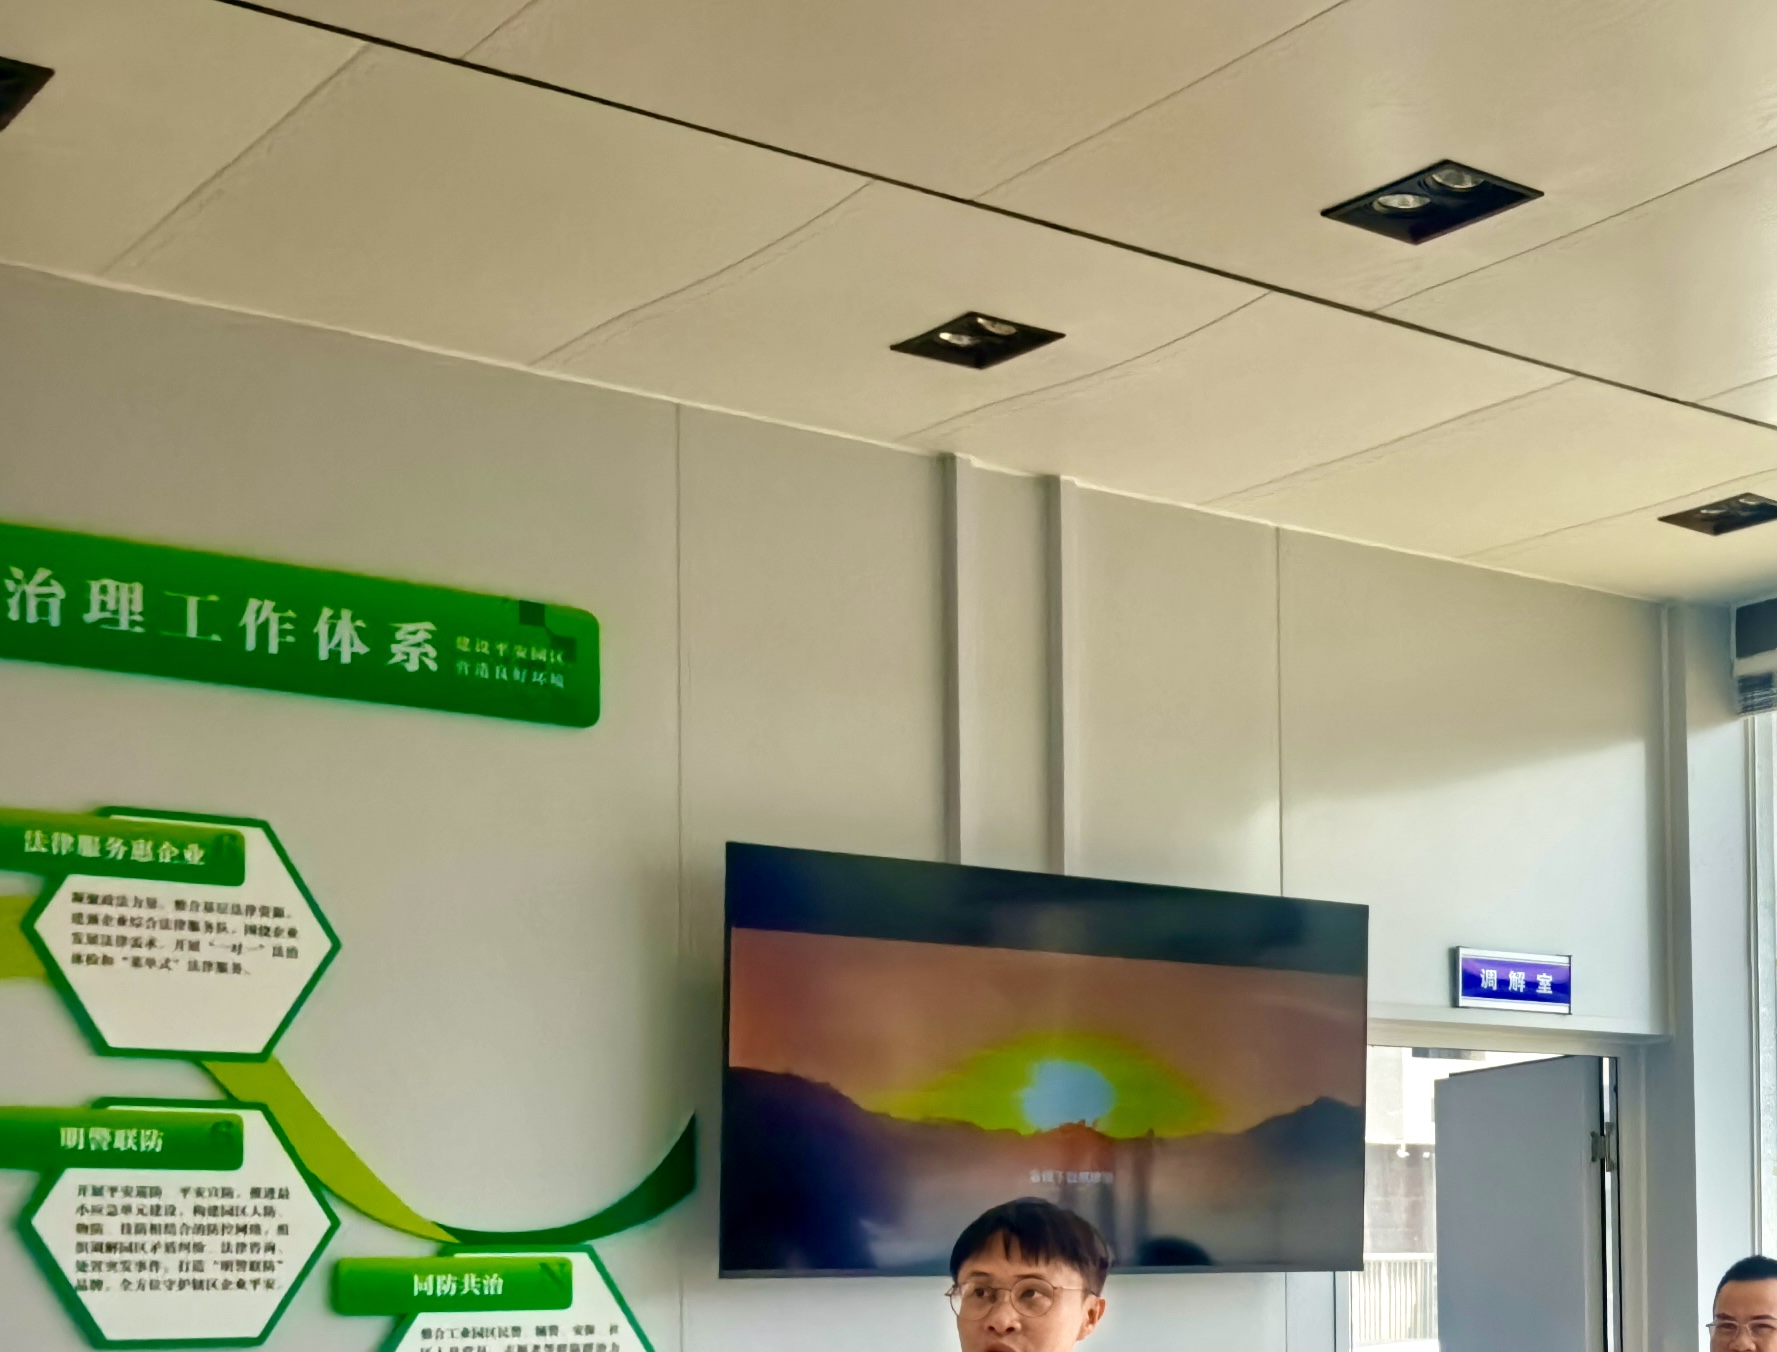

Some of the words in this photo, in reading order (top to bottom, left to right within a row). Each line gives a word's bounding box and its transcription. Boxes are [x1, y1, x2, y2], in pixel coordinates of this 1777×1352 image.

[5, 566, 439, 673] 治理工作体系
[1480, 968, 1553, 994] 调解室
[60, 1127, 163, 1152] 明警联防
[413, 1272, 504, 1297] 同防共治
